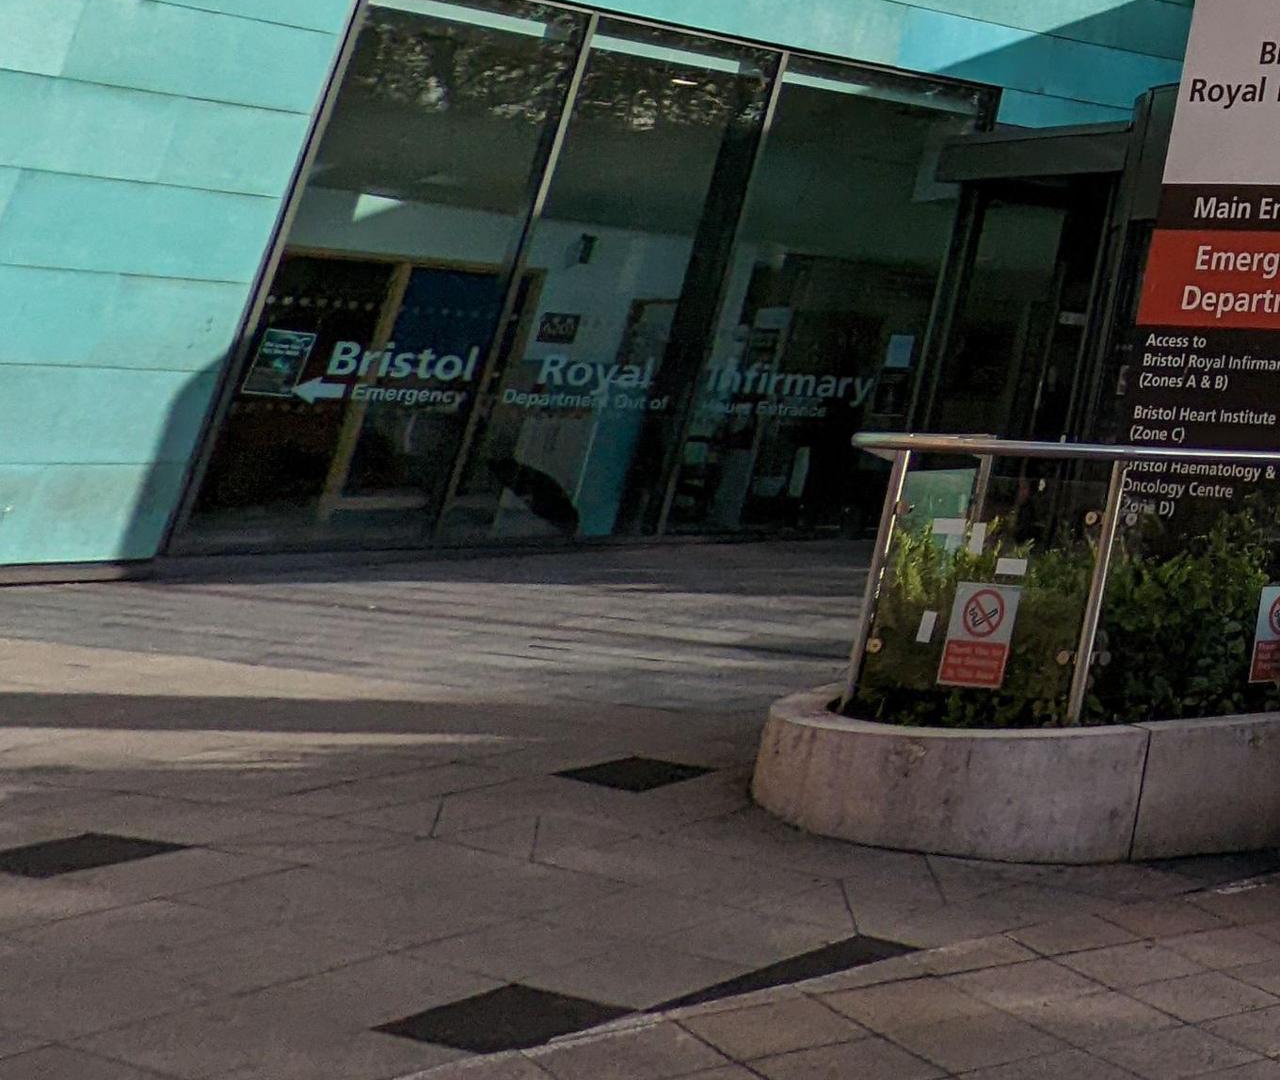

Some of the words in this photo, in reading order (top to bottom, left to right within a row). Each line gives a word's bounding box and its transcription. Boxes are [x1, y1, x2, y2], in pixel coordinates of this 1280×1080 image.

[1190, 76, 1266, 110] Royal
[1193, 196, 1251, 220] Main
[1145, 333, 1189, 348] Access
[1192, 335, 1207, 349] to
[1142, 353, 1186, 367] Bristol
[1187, 354, 1226, 372] Royal
[326, 340, 481, 382] Bristol
[537, 352, 657, 396] Royal
[706, 361, 876, 407] Infirmary
[1138, 372, 1184, 389] (Zones
[1186, 375, 1197, 388] A
[1200, 376, 1211, 389] &
[1214, 375, 1229, 391] B)
[351, 383, 468, 408] Emergency
[651, 395, 670, 412] of
[1133, 405, 1176, 421] Bristol
[1179, 407, 1216, 422] Heart
[1219, 409, 1277, 425] Institute
[1129, 425, 1168, 441] (Zone
[1171, 427, 1185, 443] C)
[1171, 461, 1261, 482] Haematology
[1265, 465, 1276, 480] &
[1122, 477, 1186, 499] Oncology
[1188, 482, 1234, 499] Centre
[1122, 497, 1156, 514] Zone
[1159, 500, 1175, 518] D)
